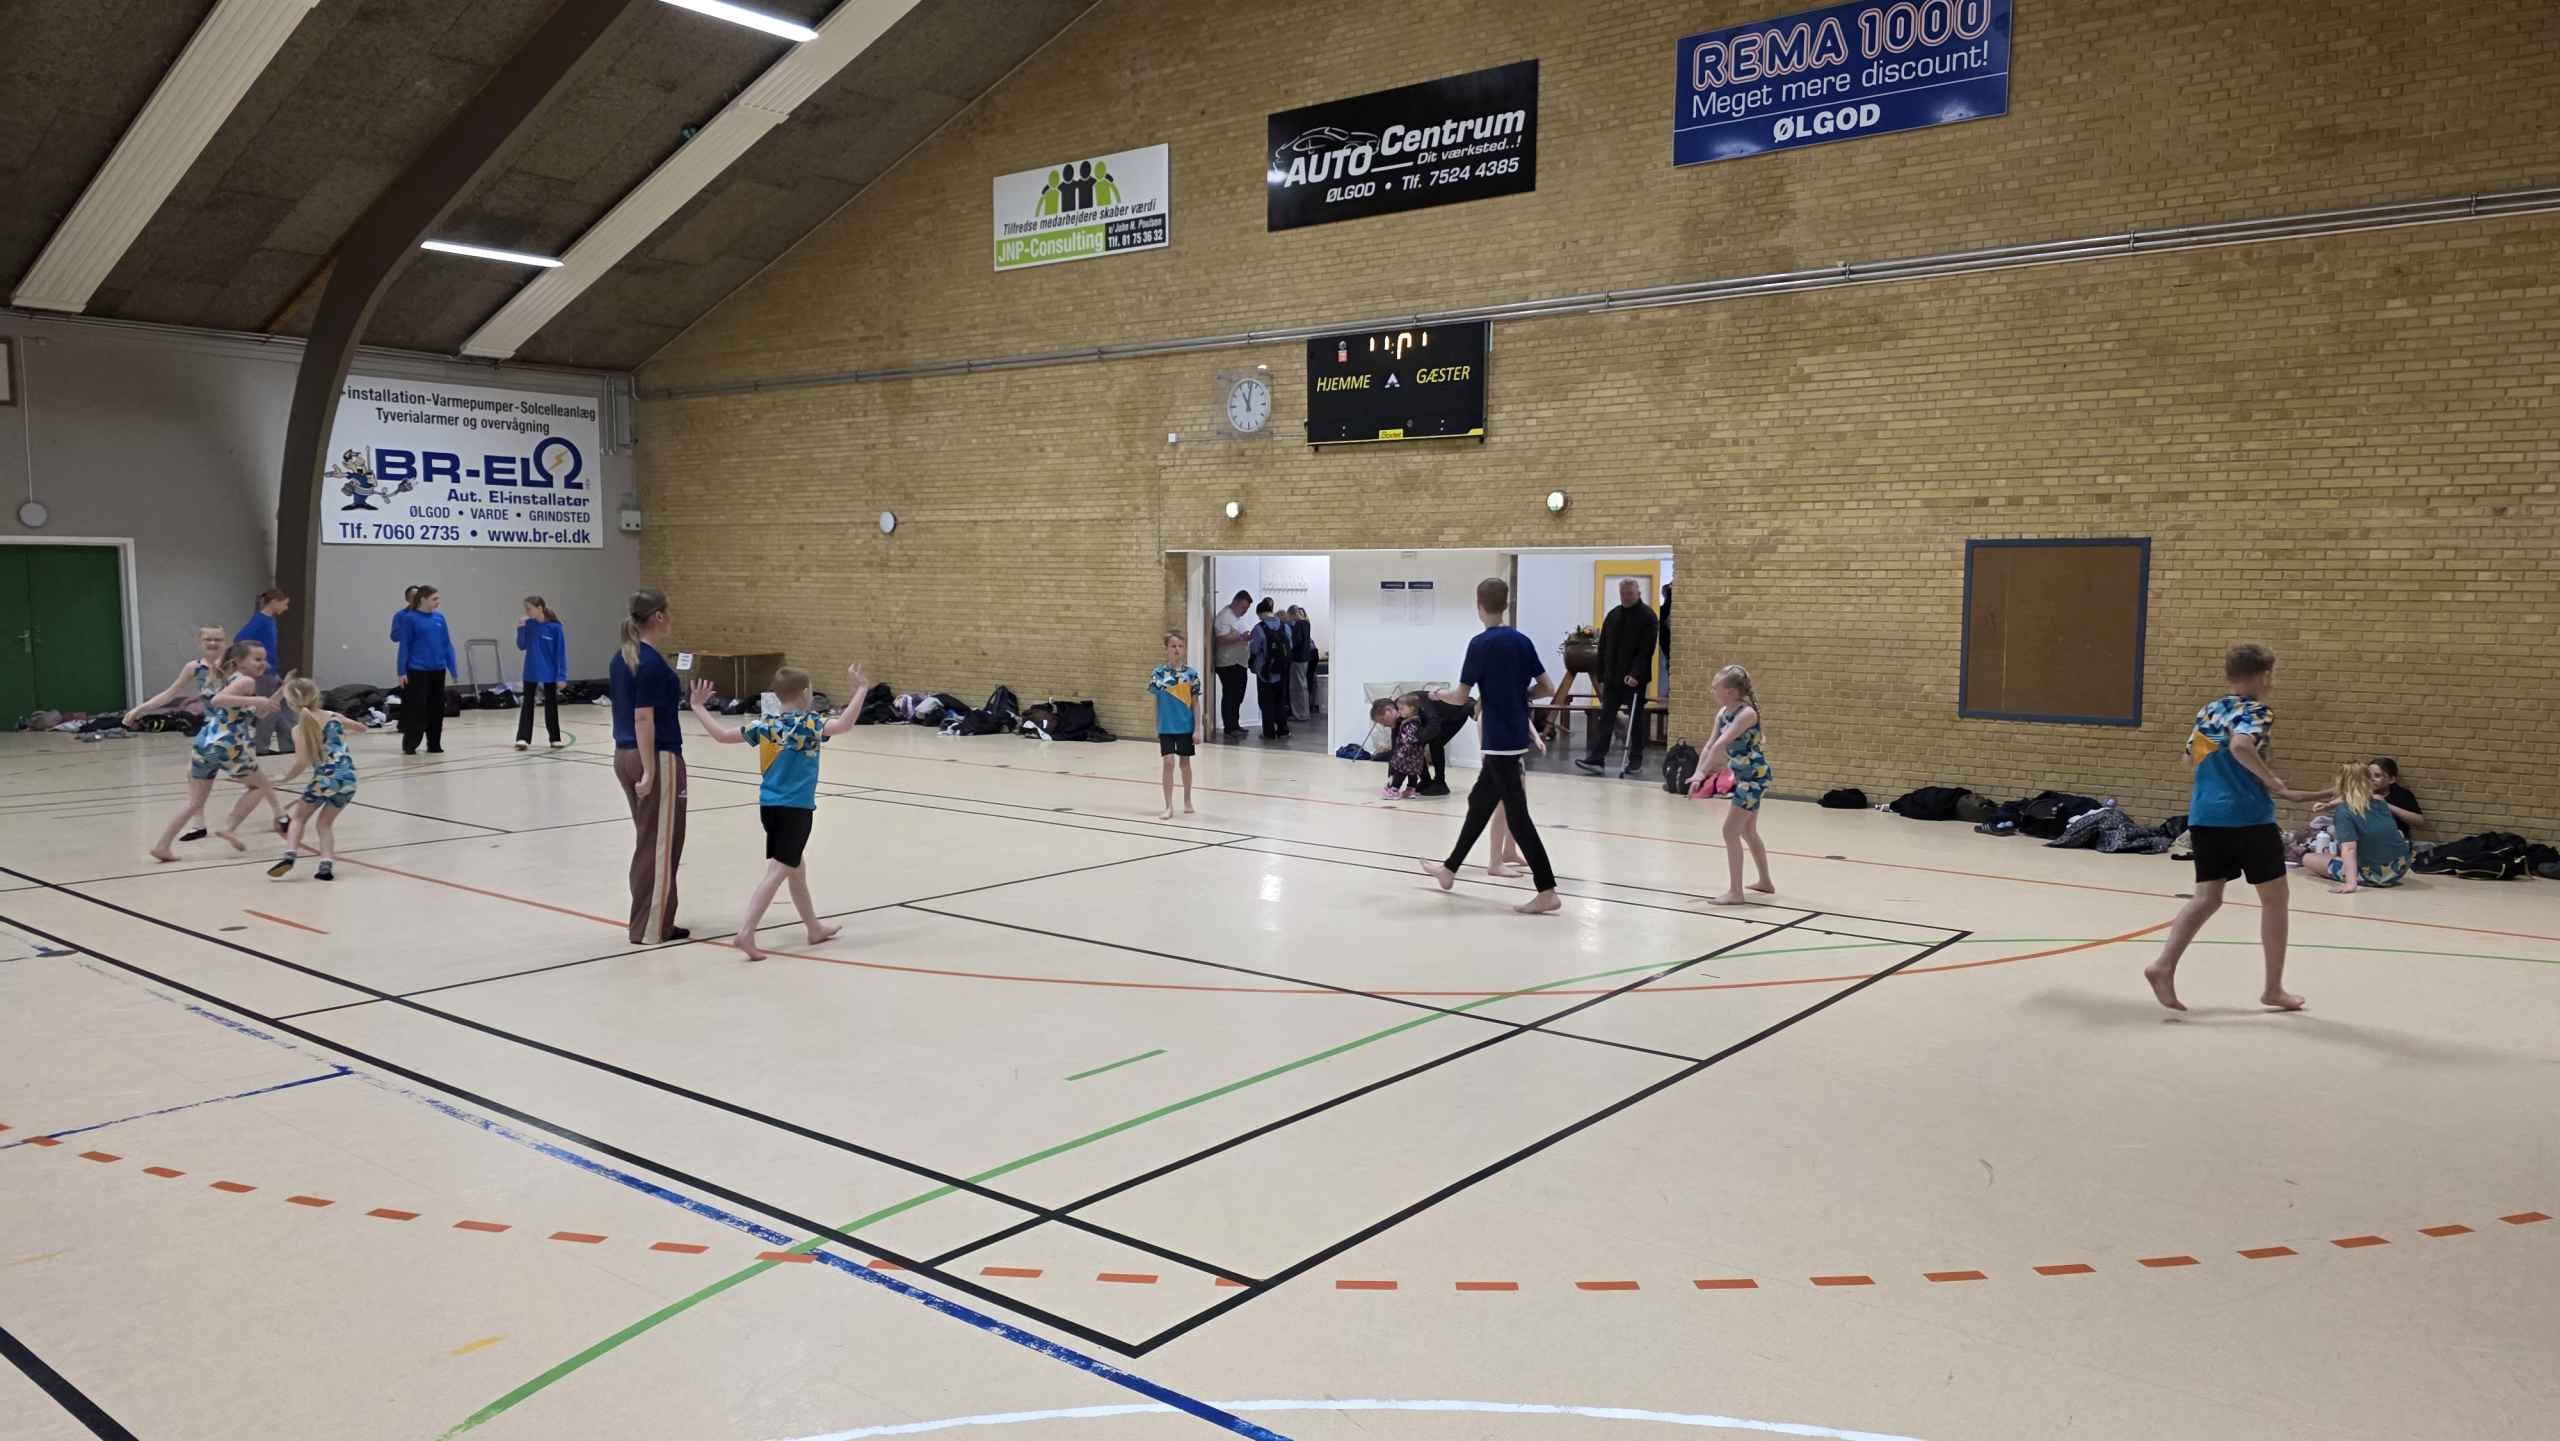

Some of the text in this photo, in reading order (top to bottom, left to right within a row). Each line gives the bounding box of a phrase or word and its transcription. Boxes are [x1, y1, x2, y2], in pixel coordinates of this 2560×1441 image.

[1692, 0, 1990, 91] REMA 1000
[1692, 41, 1989, 118] Meget mere discount!
[1773, 103, 1881, 143] ØLGOD
[1284, 109, 1526, 188] AUTO Centrum
[1417, 136, 1521, 165] Dit værksted..!
[1326, 157, 1520, 203] ØLGOD Tlf. 7524 4385
[1040, 209, 1097, 229] medarbejdere
[1100, 203, 1129, 219] skaber
[998, 230, 1104, 262] JNP-Consulting
[1316, 365, 1471, 392] HJEMME GÆSTER
[376, 406, 550, 435] Tyverialarmer og overvågning
[447, 488, 590, 507] Aut. El-installatør
[409, 506, 590, 523] ØLGOD VARDE GRINDSTED
[339, 522, 591, 543] Tlf. 7060 2735 www.br-el.dk
